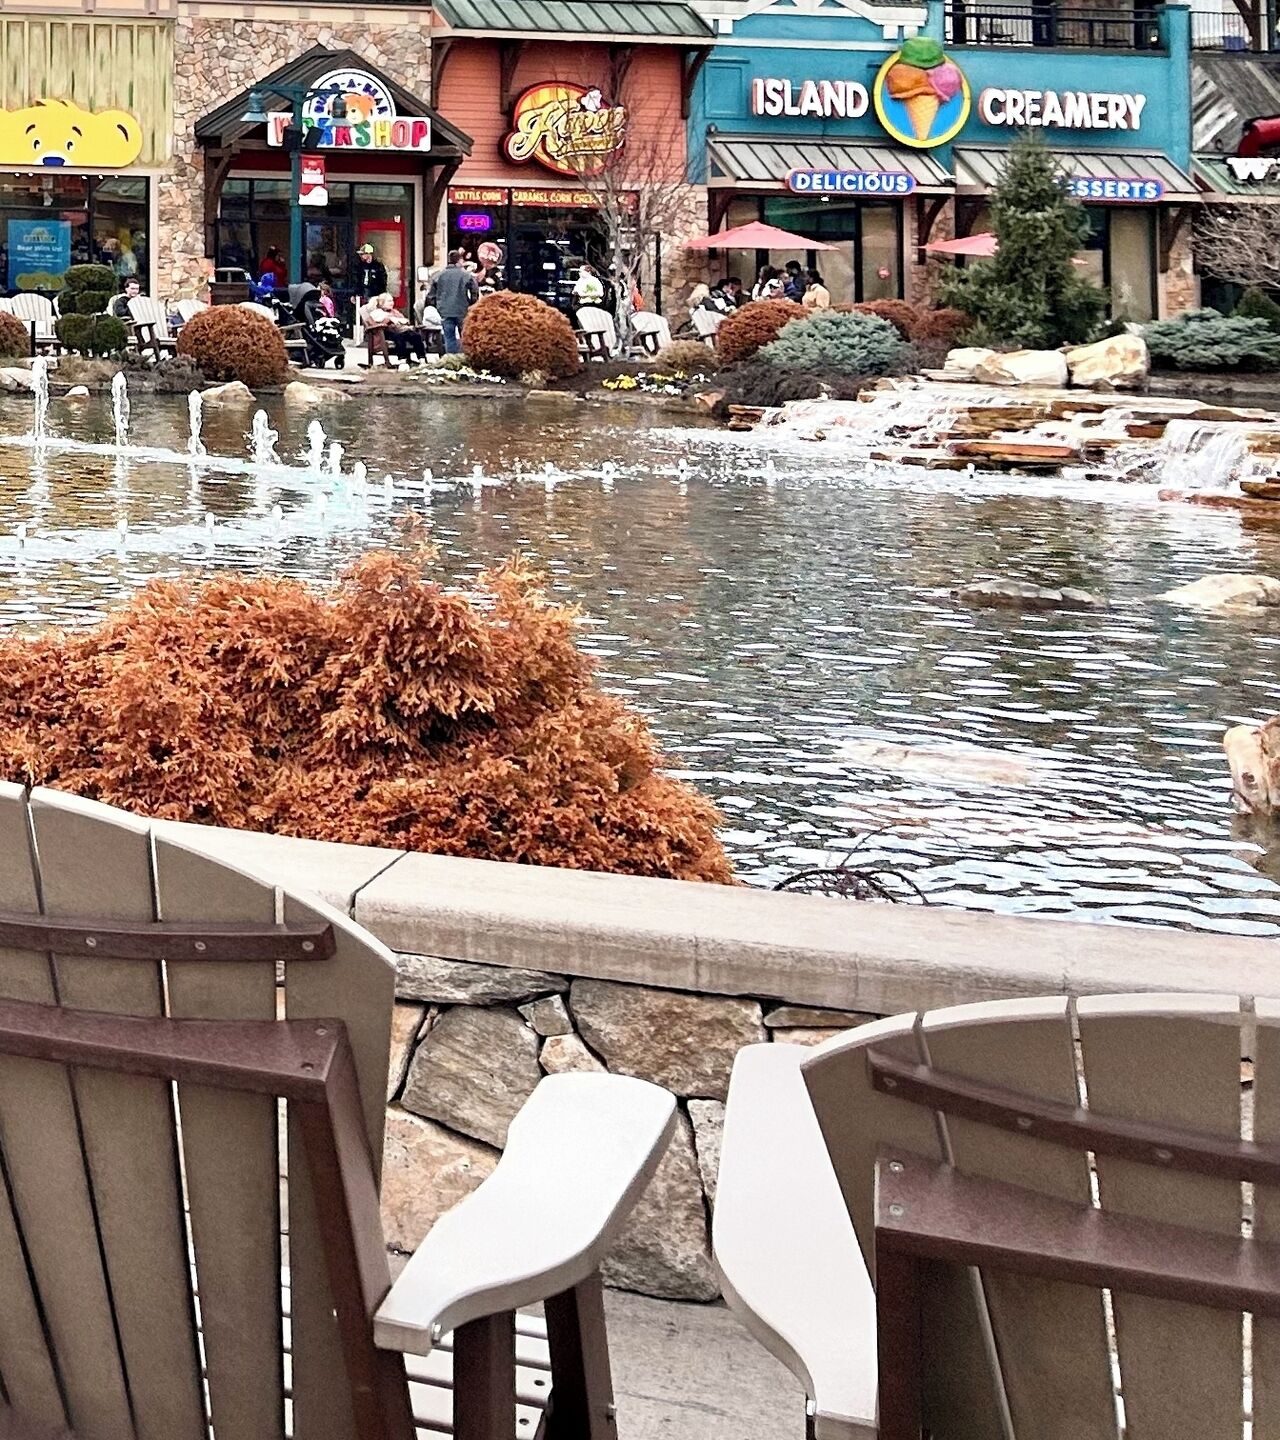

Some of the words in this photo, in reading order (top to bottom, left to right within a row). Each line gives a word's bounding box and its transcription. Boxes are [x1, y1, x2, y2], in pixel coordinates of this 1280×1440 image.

[752, 78, 870, 119] ISLAND
[980, 88, 1147, 130] CREAMERY
[795, 172, 909, 193] DELICIOUS
[454, 191, 481, 202] KETTLE
[482, 191, 502, 202] CORN
[511, 192, 549, 203] CARAMEL
[549, 193, 573, 204] CORN
[461, 216, 488, 228] OPEN
